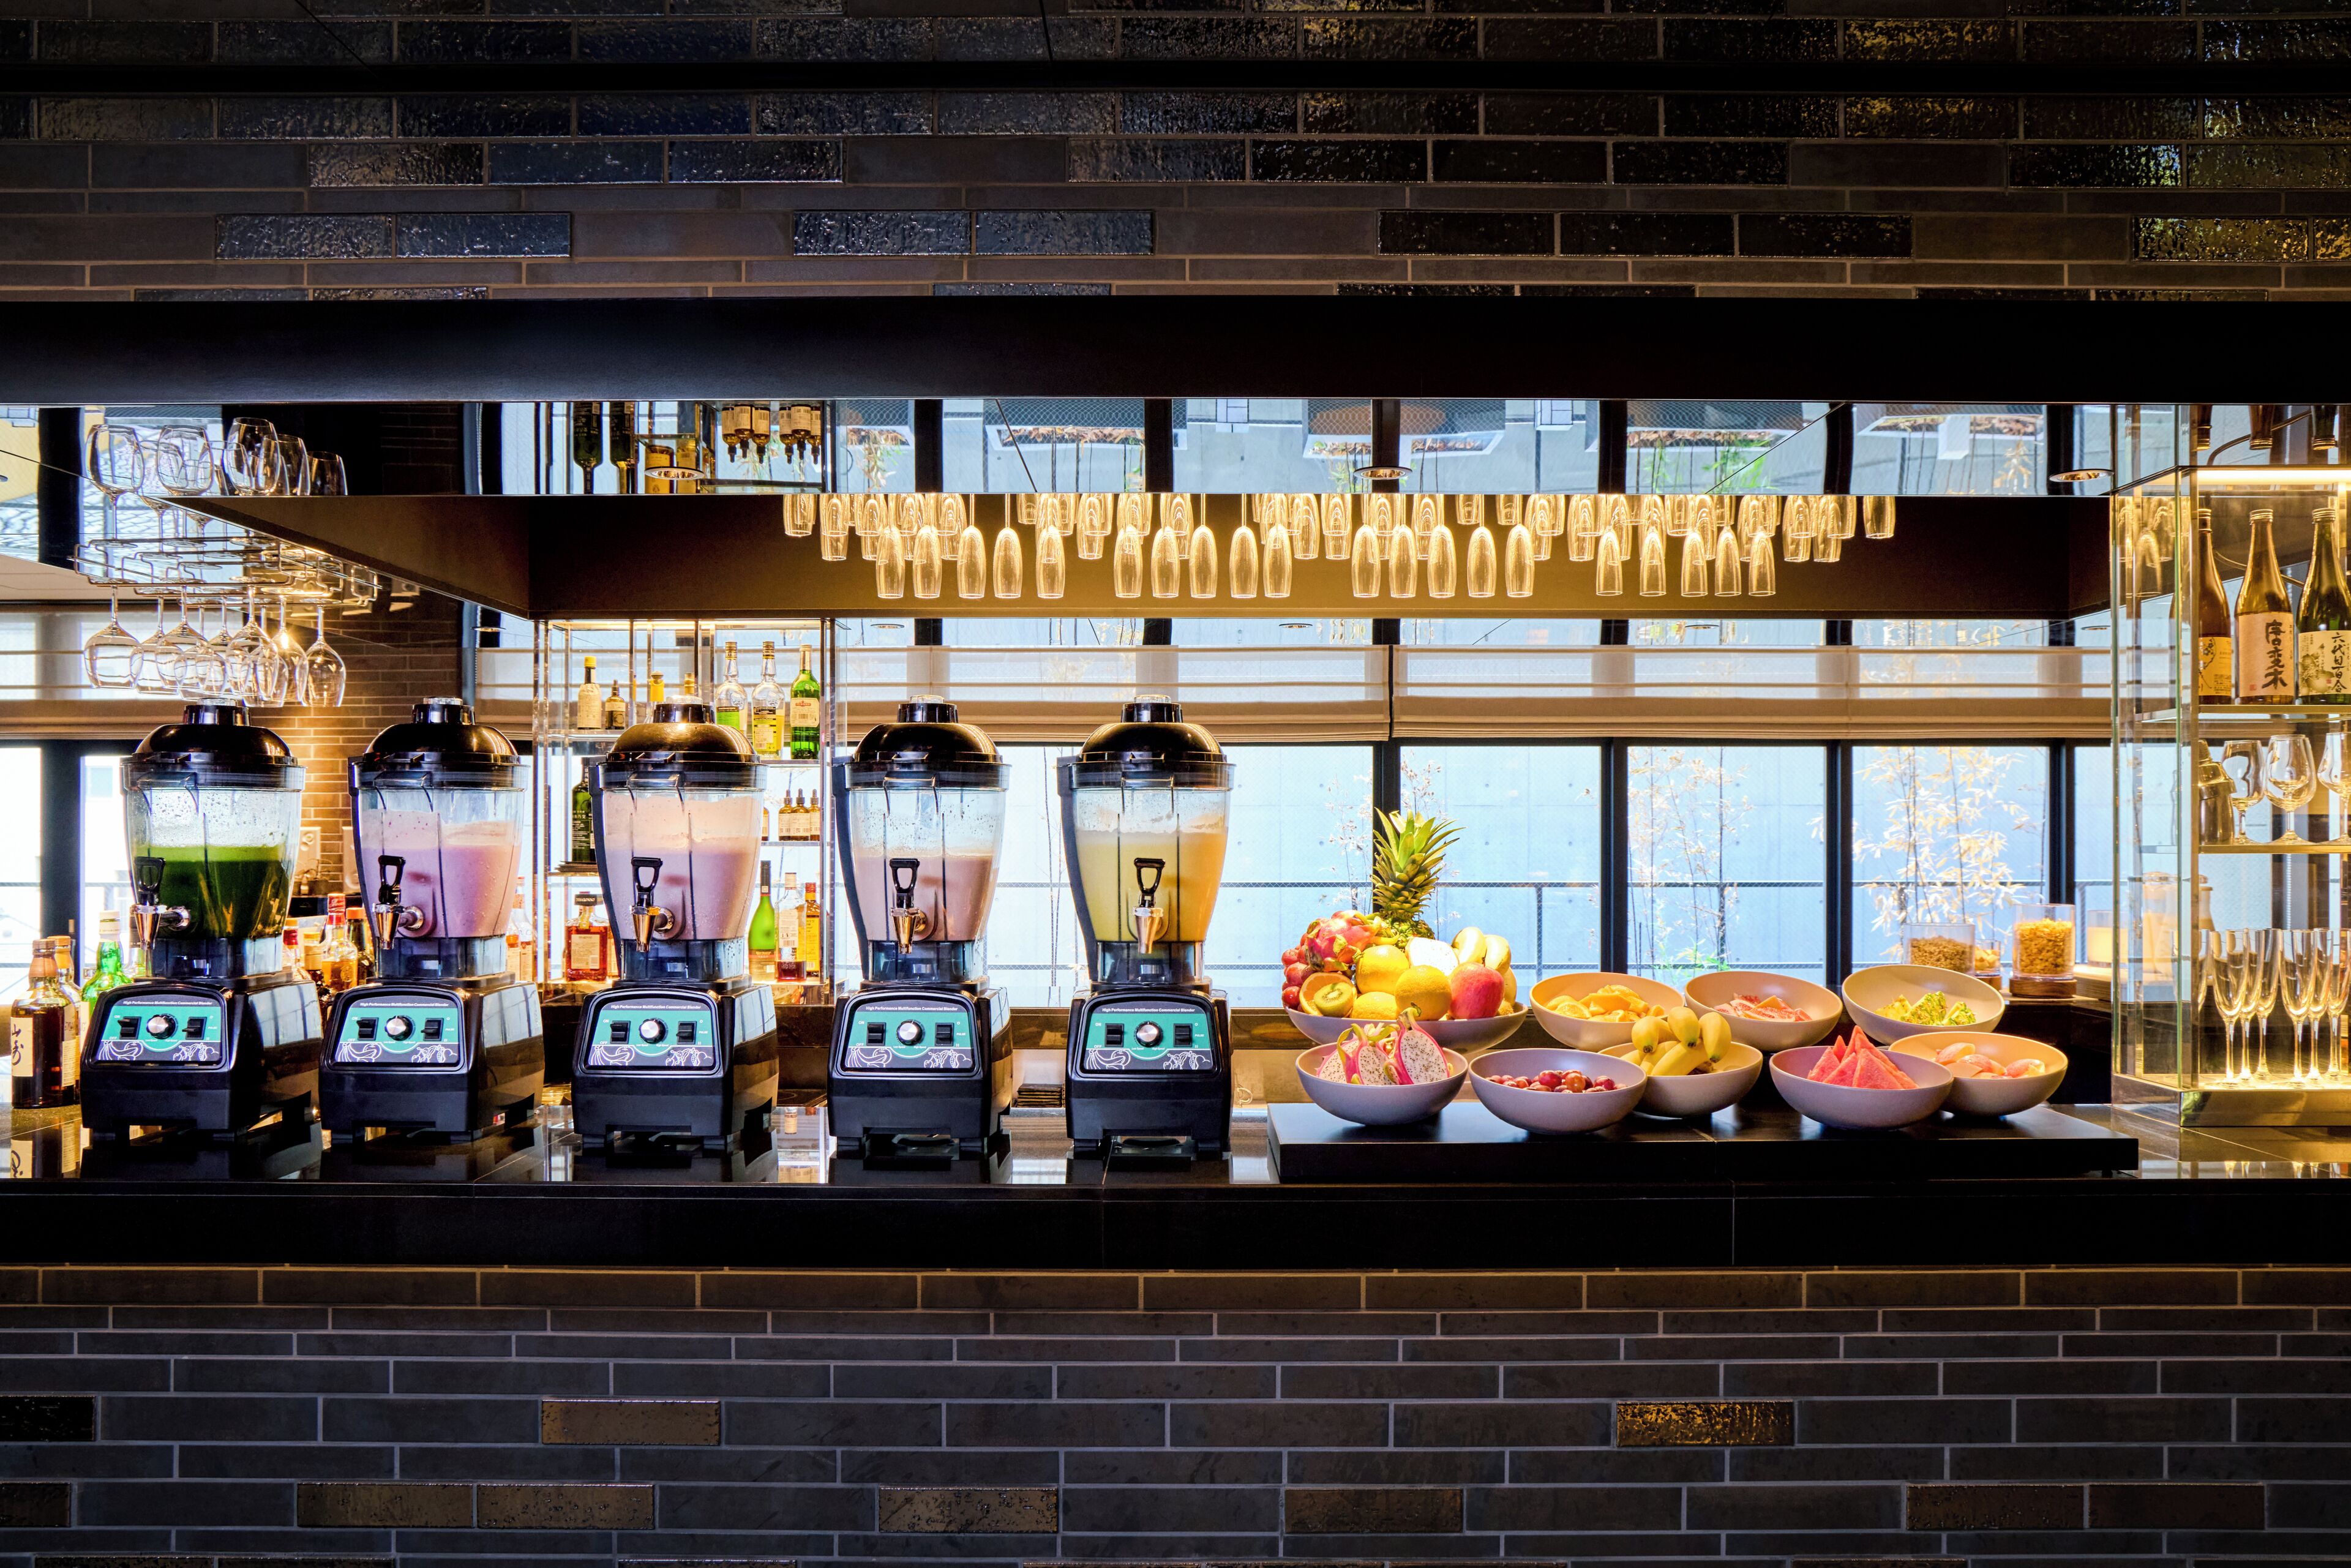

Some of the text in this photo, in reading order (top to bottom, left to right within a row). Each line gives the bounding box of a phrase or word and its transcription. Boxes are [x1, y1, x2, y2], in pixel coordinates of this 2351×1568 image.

[2262, 619, 2288, 689] 唐変木
[2331, 632, 2347, 692] 六代目百合
